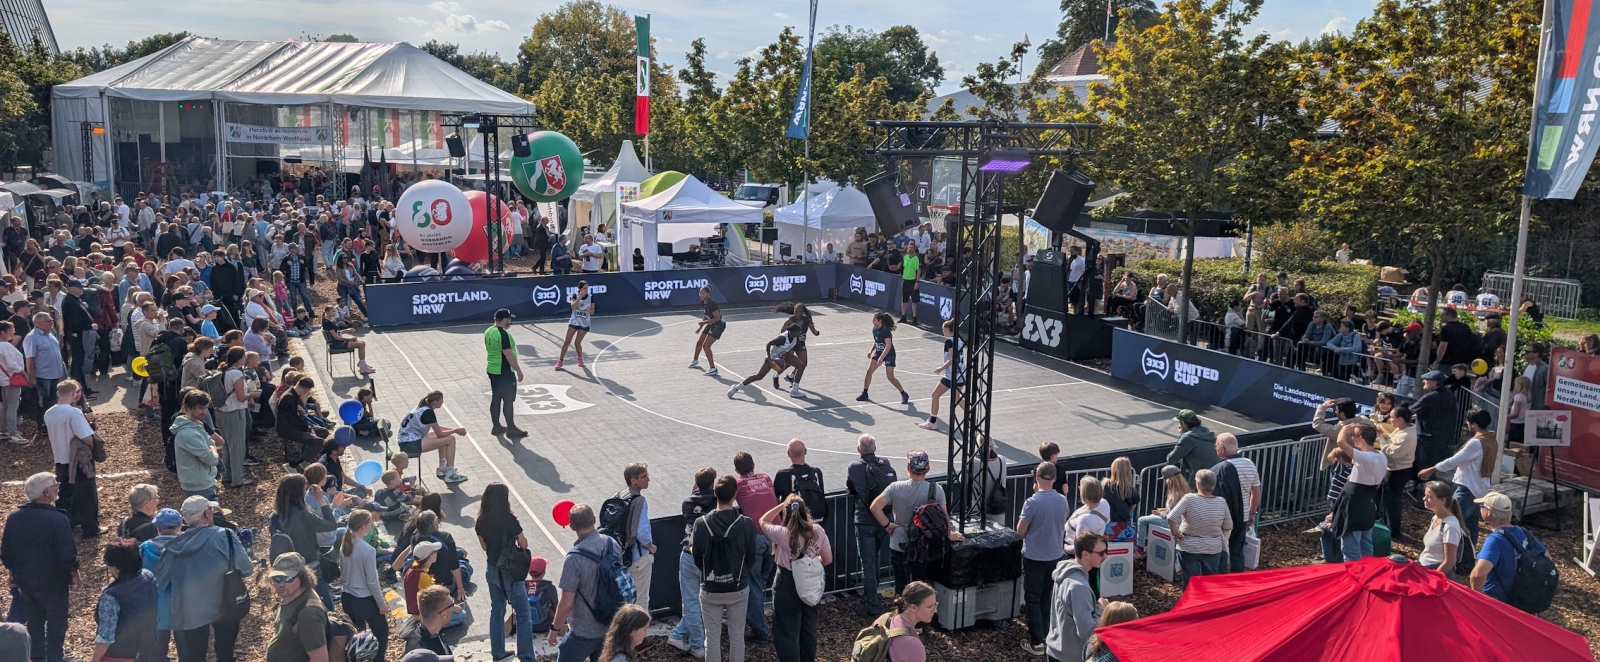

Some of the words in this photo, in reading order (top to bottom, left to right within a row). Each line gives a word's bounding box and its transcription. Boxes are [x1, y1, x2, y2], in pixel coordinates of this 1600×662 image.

[252, 134, 312, 142] Nordrhein-Westfalen
[773, 275, 806, 284] UNITED
[773, 283, 792, 292] CUP
[865, 280, 886, 292] UNITED
[537, 292, 556, 300] 3X3
[644, 290, 671, 300] NRW
[865, 288, 877, 296] CUP
[412, 291, 491, 304] SPORTLAND.
[413, 304, 444, 315] NRW
[1146, 358, 1165, 370] 3X3
[1174, 360, 1219, 381] UNITED
[1174, 371, 1199, 386] CUP
[1274, 383, 1283, 392] Die
[1557, 387, 1578, 396] unser
[1580, 391, 1599, 401] Land.
